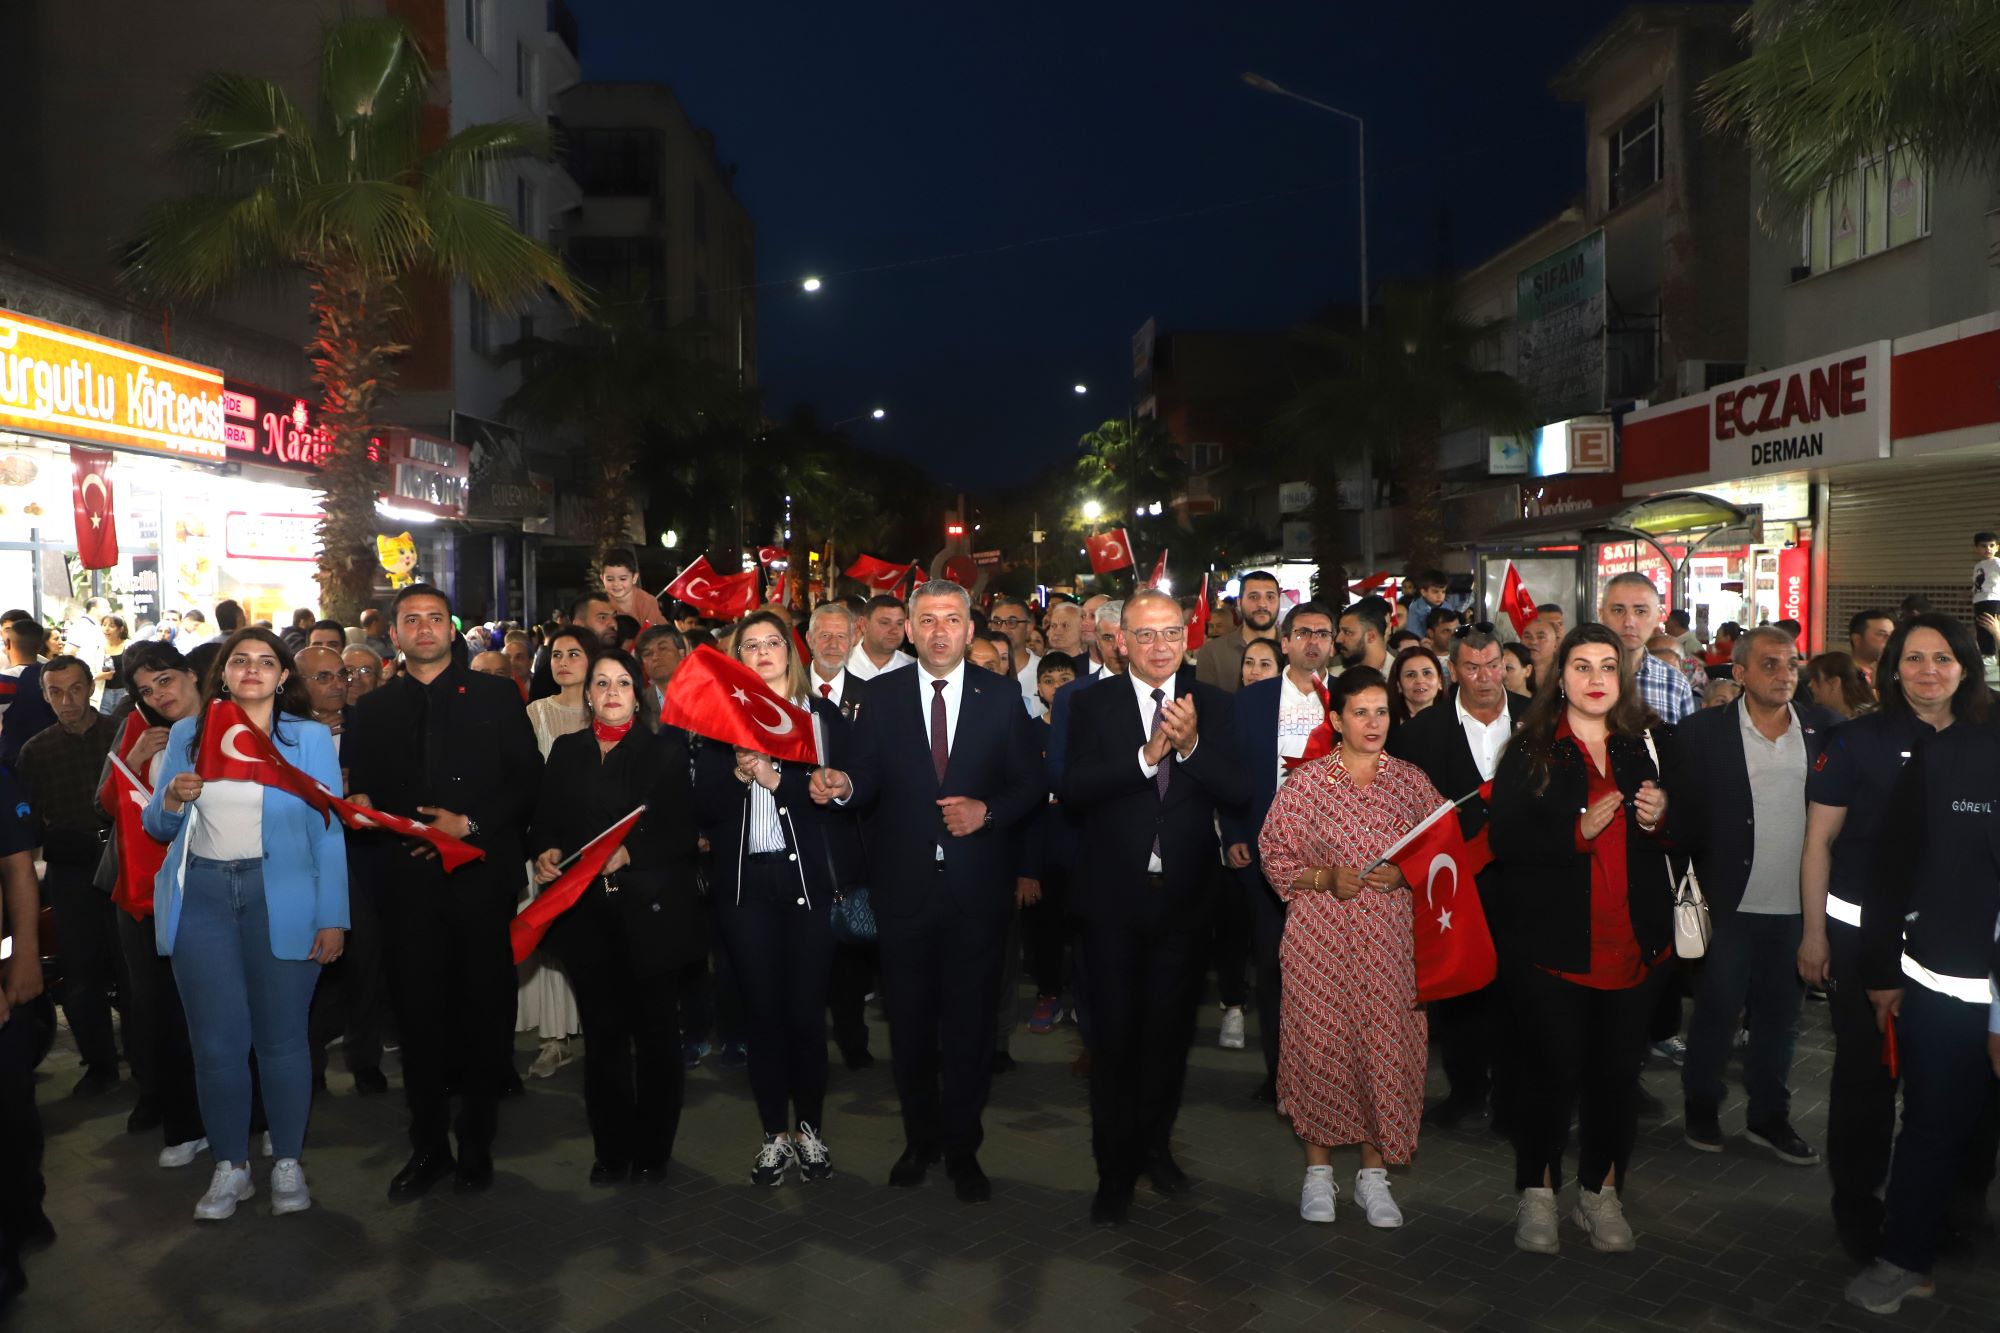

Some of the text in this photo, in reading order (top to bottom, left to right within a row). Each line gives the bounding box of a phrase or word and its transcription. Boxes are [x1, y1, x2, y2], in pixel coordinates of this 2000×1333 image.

[0, 350, 225, 442] urgutlu Köftecisi
[1715, 355, 1867, 440] ECZANE
[1580, 432, 1602, 462] E
[1751, 432, 1823, 466] DERMAN
[1785, 575, 1800, 621] afone
